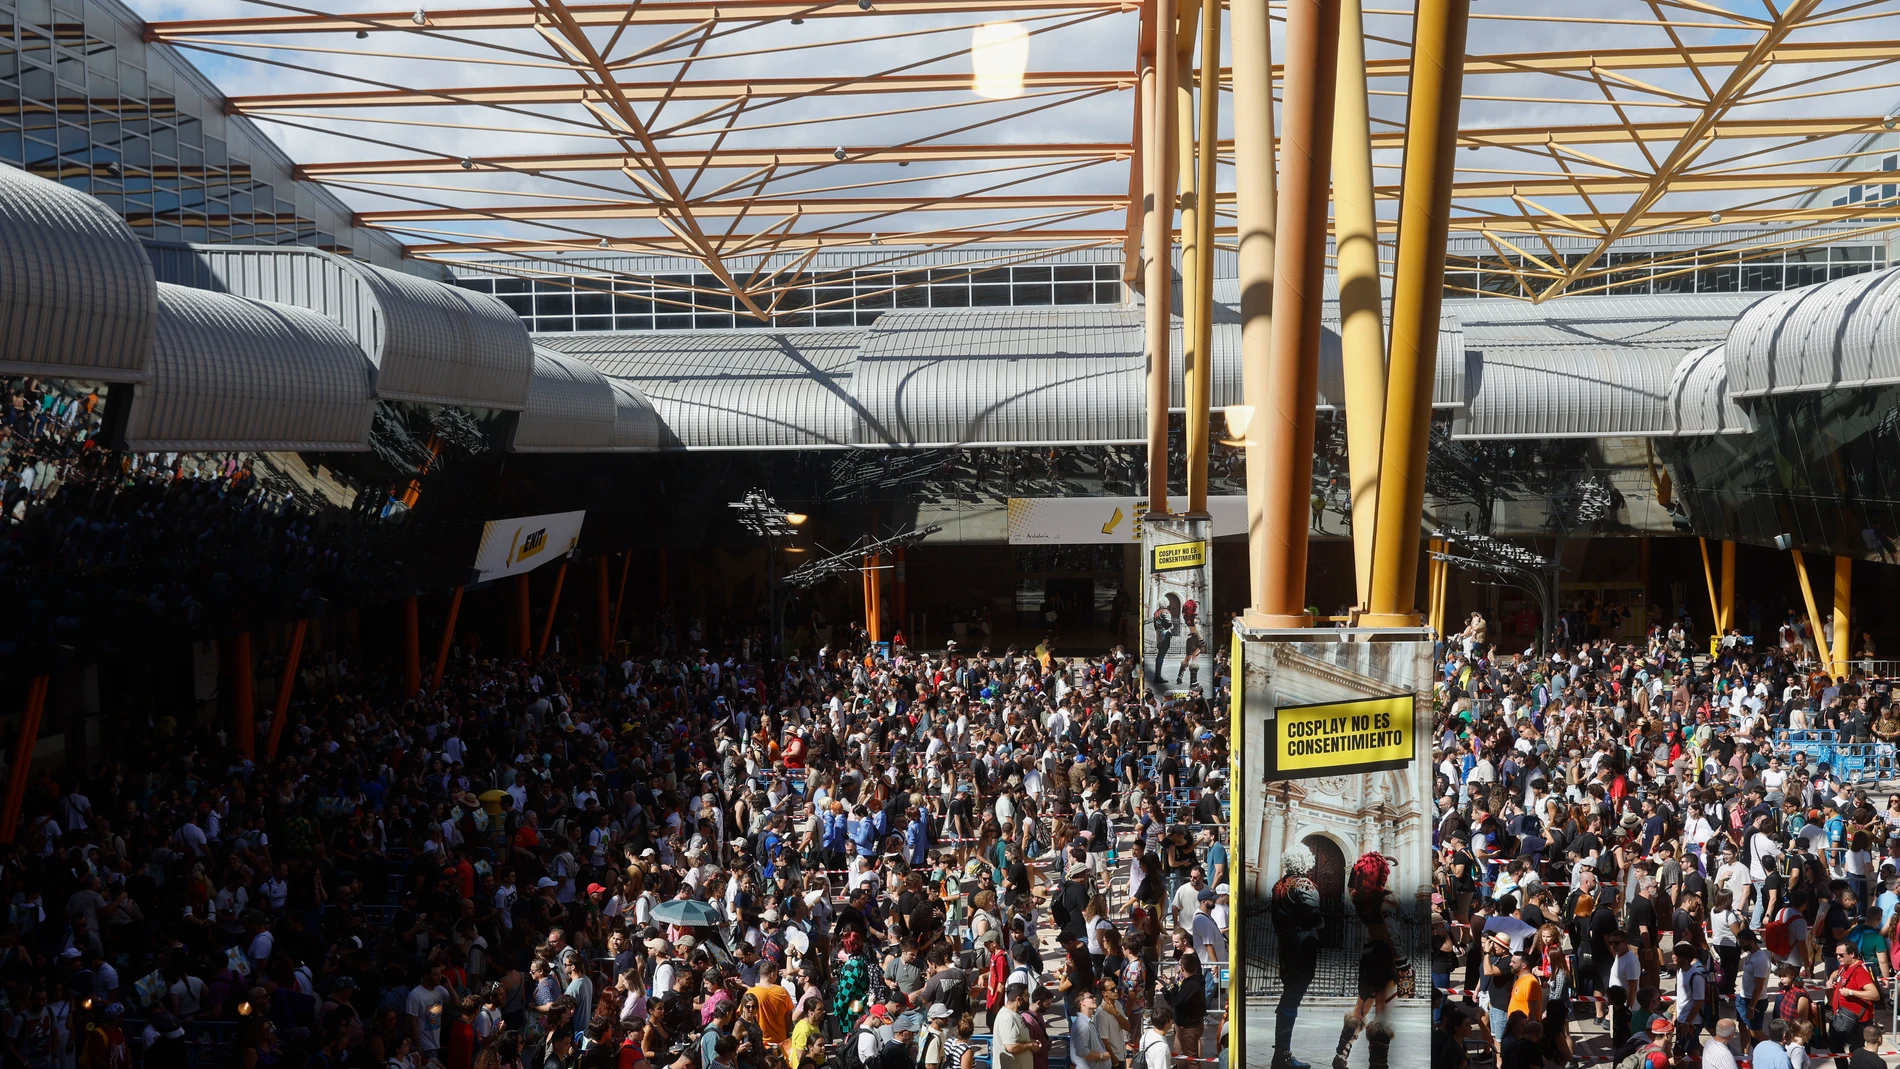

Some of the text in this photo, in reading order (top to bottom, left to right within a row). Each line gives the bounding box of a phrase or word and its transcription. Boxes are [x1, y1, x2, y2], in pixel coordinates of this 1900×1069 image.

[523, 528, 546, 553] EXIT
[1159, 549, 1181, 557] COSPLAY
[1159, 554, 1201, 564] CONSENTIMIENTO
[1287, 712, 1390, 739] COSPLAY NO ES
[1287, 730, 1402, 757] CONSENTIMIENTO
